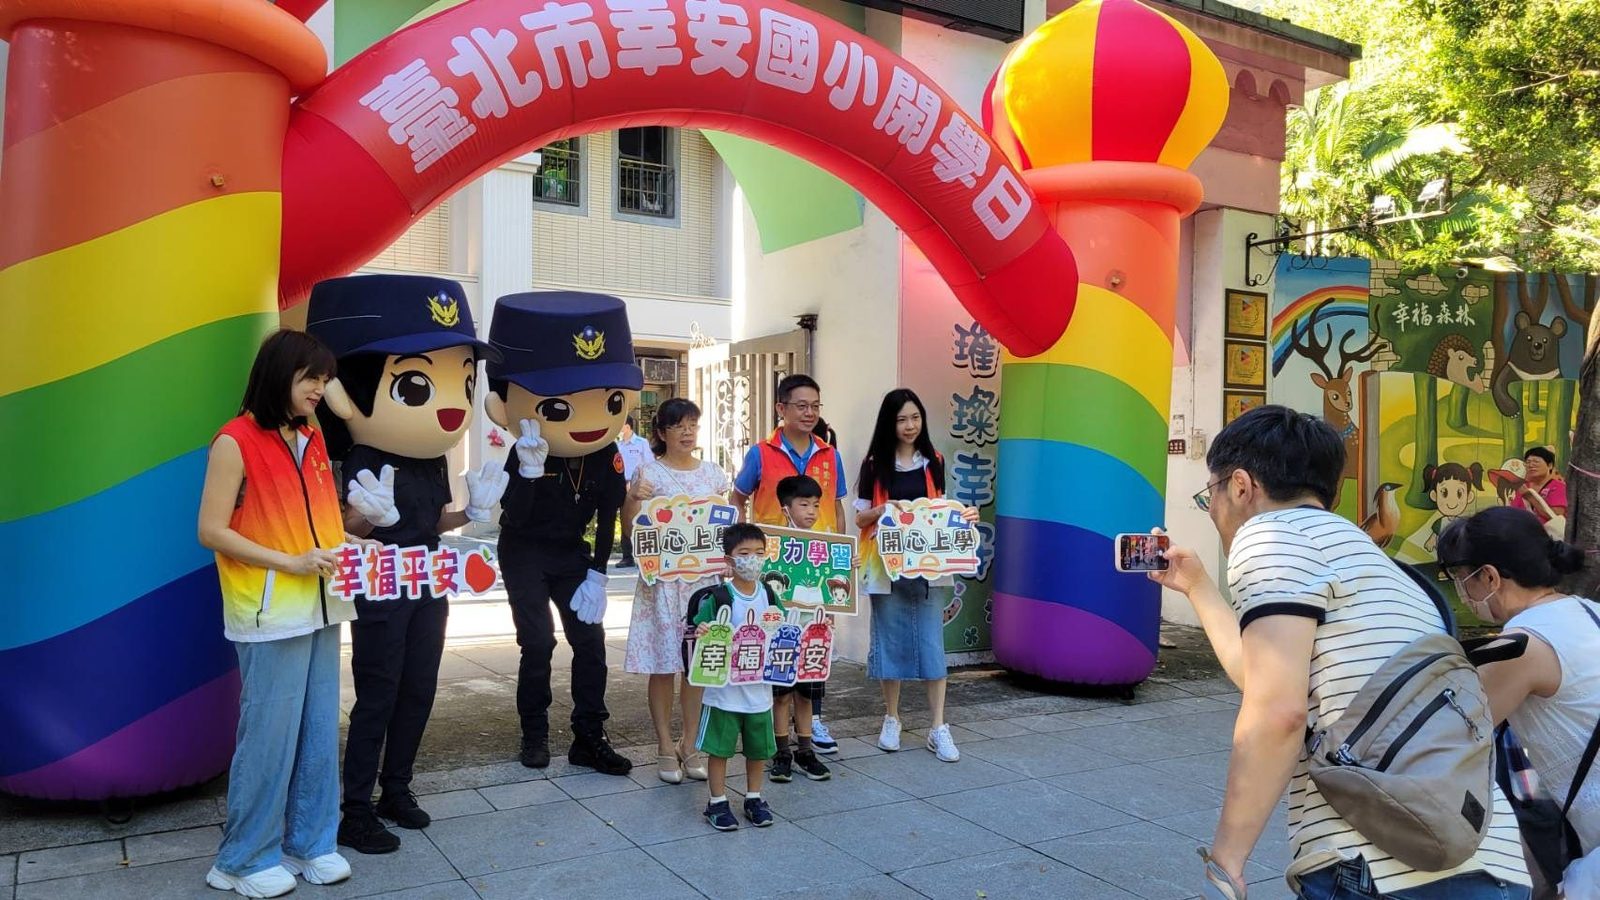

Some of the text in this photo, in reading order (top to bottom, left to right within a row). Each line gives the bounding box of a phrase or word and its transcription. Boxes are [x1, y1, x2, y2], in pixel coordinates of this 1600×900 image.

[359, 0, 1032, 241] 臺北市幸安國小開學日
[1392, 301, 1476, 332] 幸福森林
[881, 529, 975, 554] 開心上學
[332, 547, 459, 597] 幸福平安
